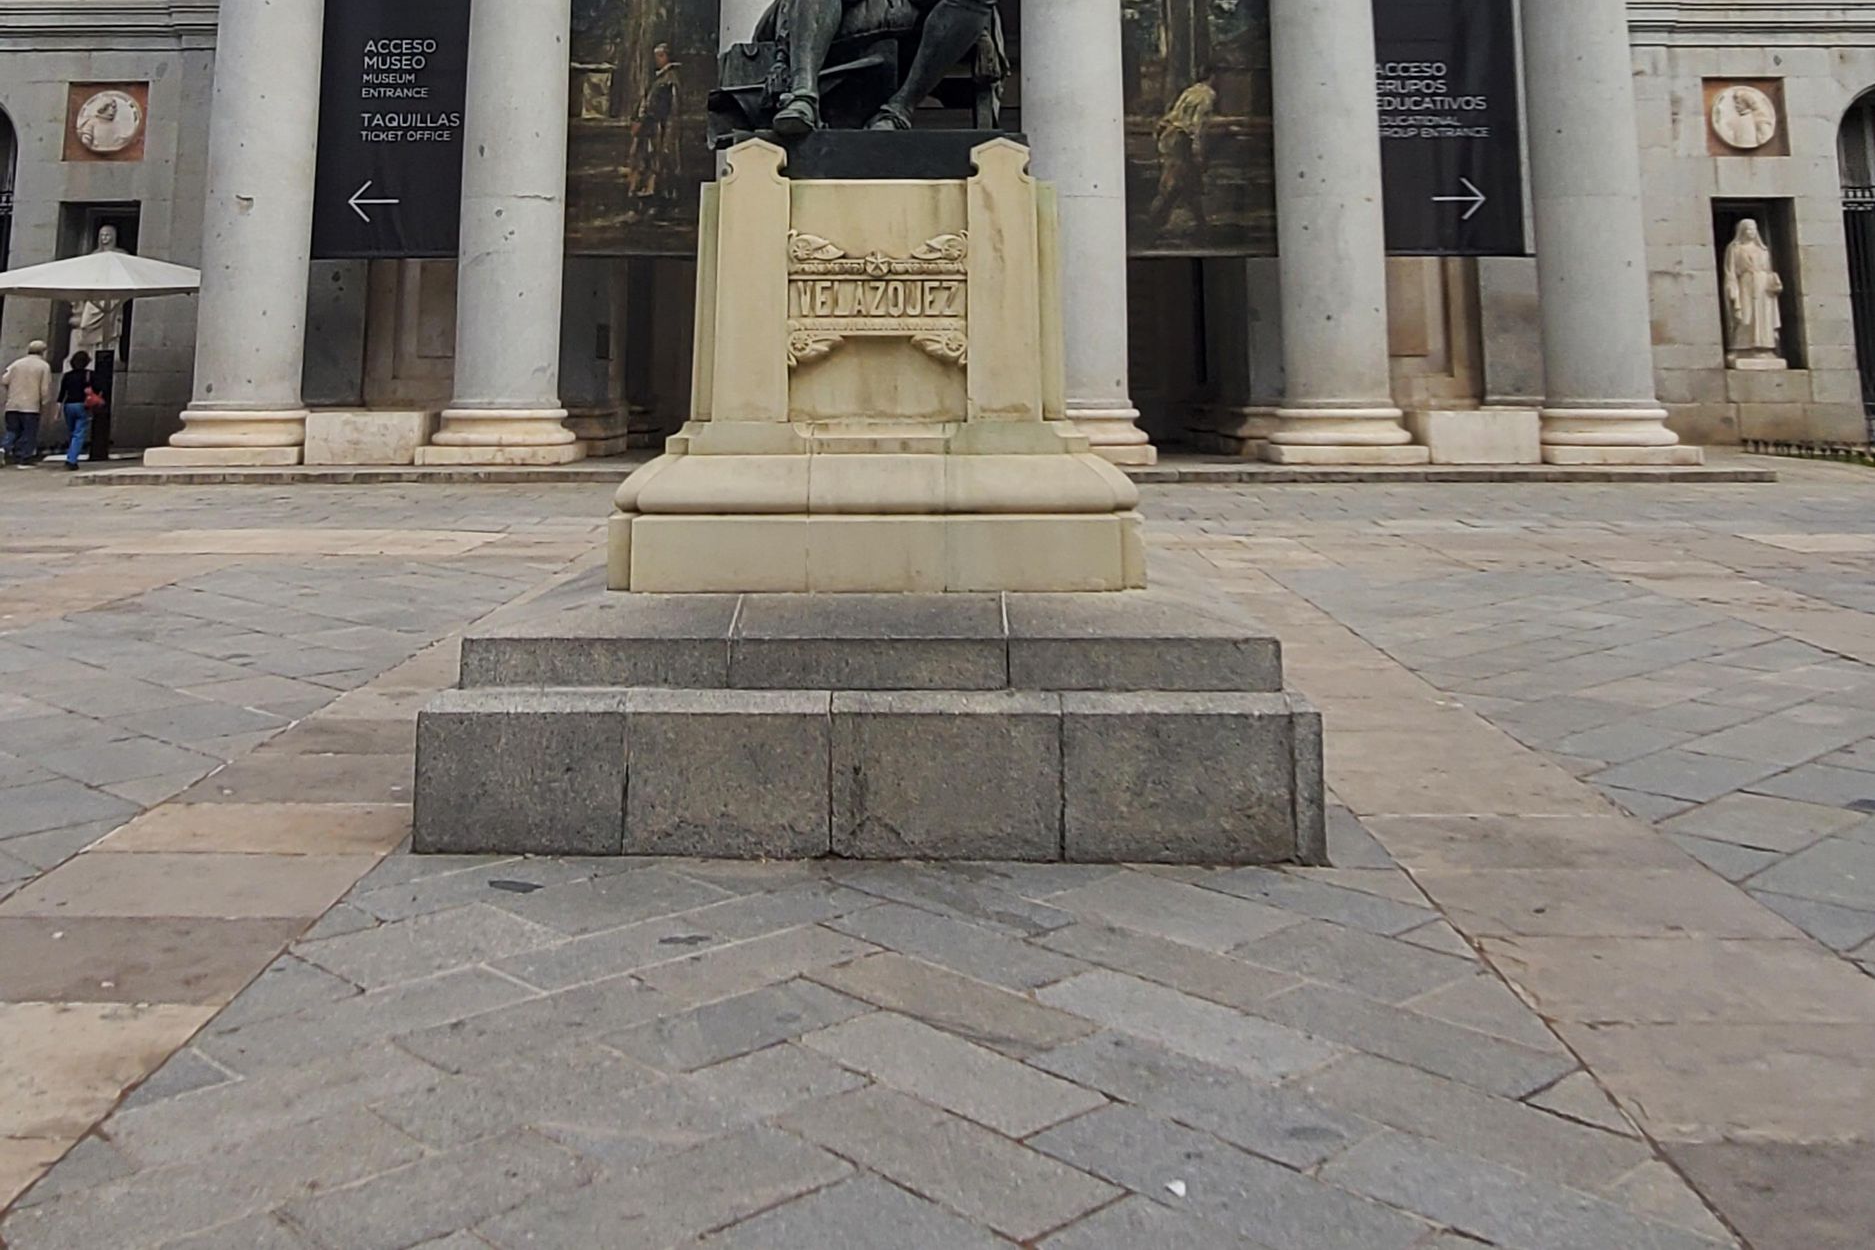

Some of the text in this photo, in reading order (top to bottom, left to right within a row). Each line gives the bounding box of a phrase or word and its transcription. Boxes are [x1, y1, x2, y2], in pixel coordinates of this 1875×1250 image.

[364, 39, 436, 53] ACCESO
[363, 55, 425, 69] MUSEO
[362, 73, 415, 83] MUSEUM
[361, 87, 429, 97] ENTRANCE
[360, 112, 460, 126] TAQUILLAS
[1379, 115, 1462, 125] DUCATIONAL
[360, 130, 451, 140] TICKET OFFICE
[1378, 127, 1490, 137] ROUP ENTRANCE
[797, 280, 960, 317] VELAZQUEZ
